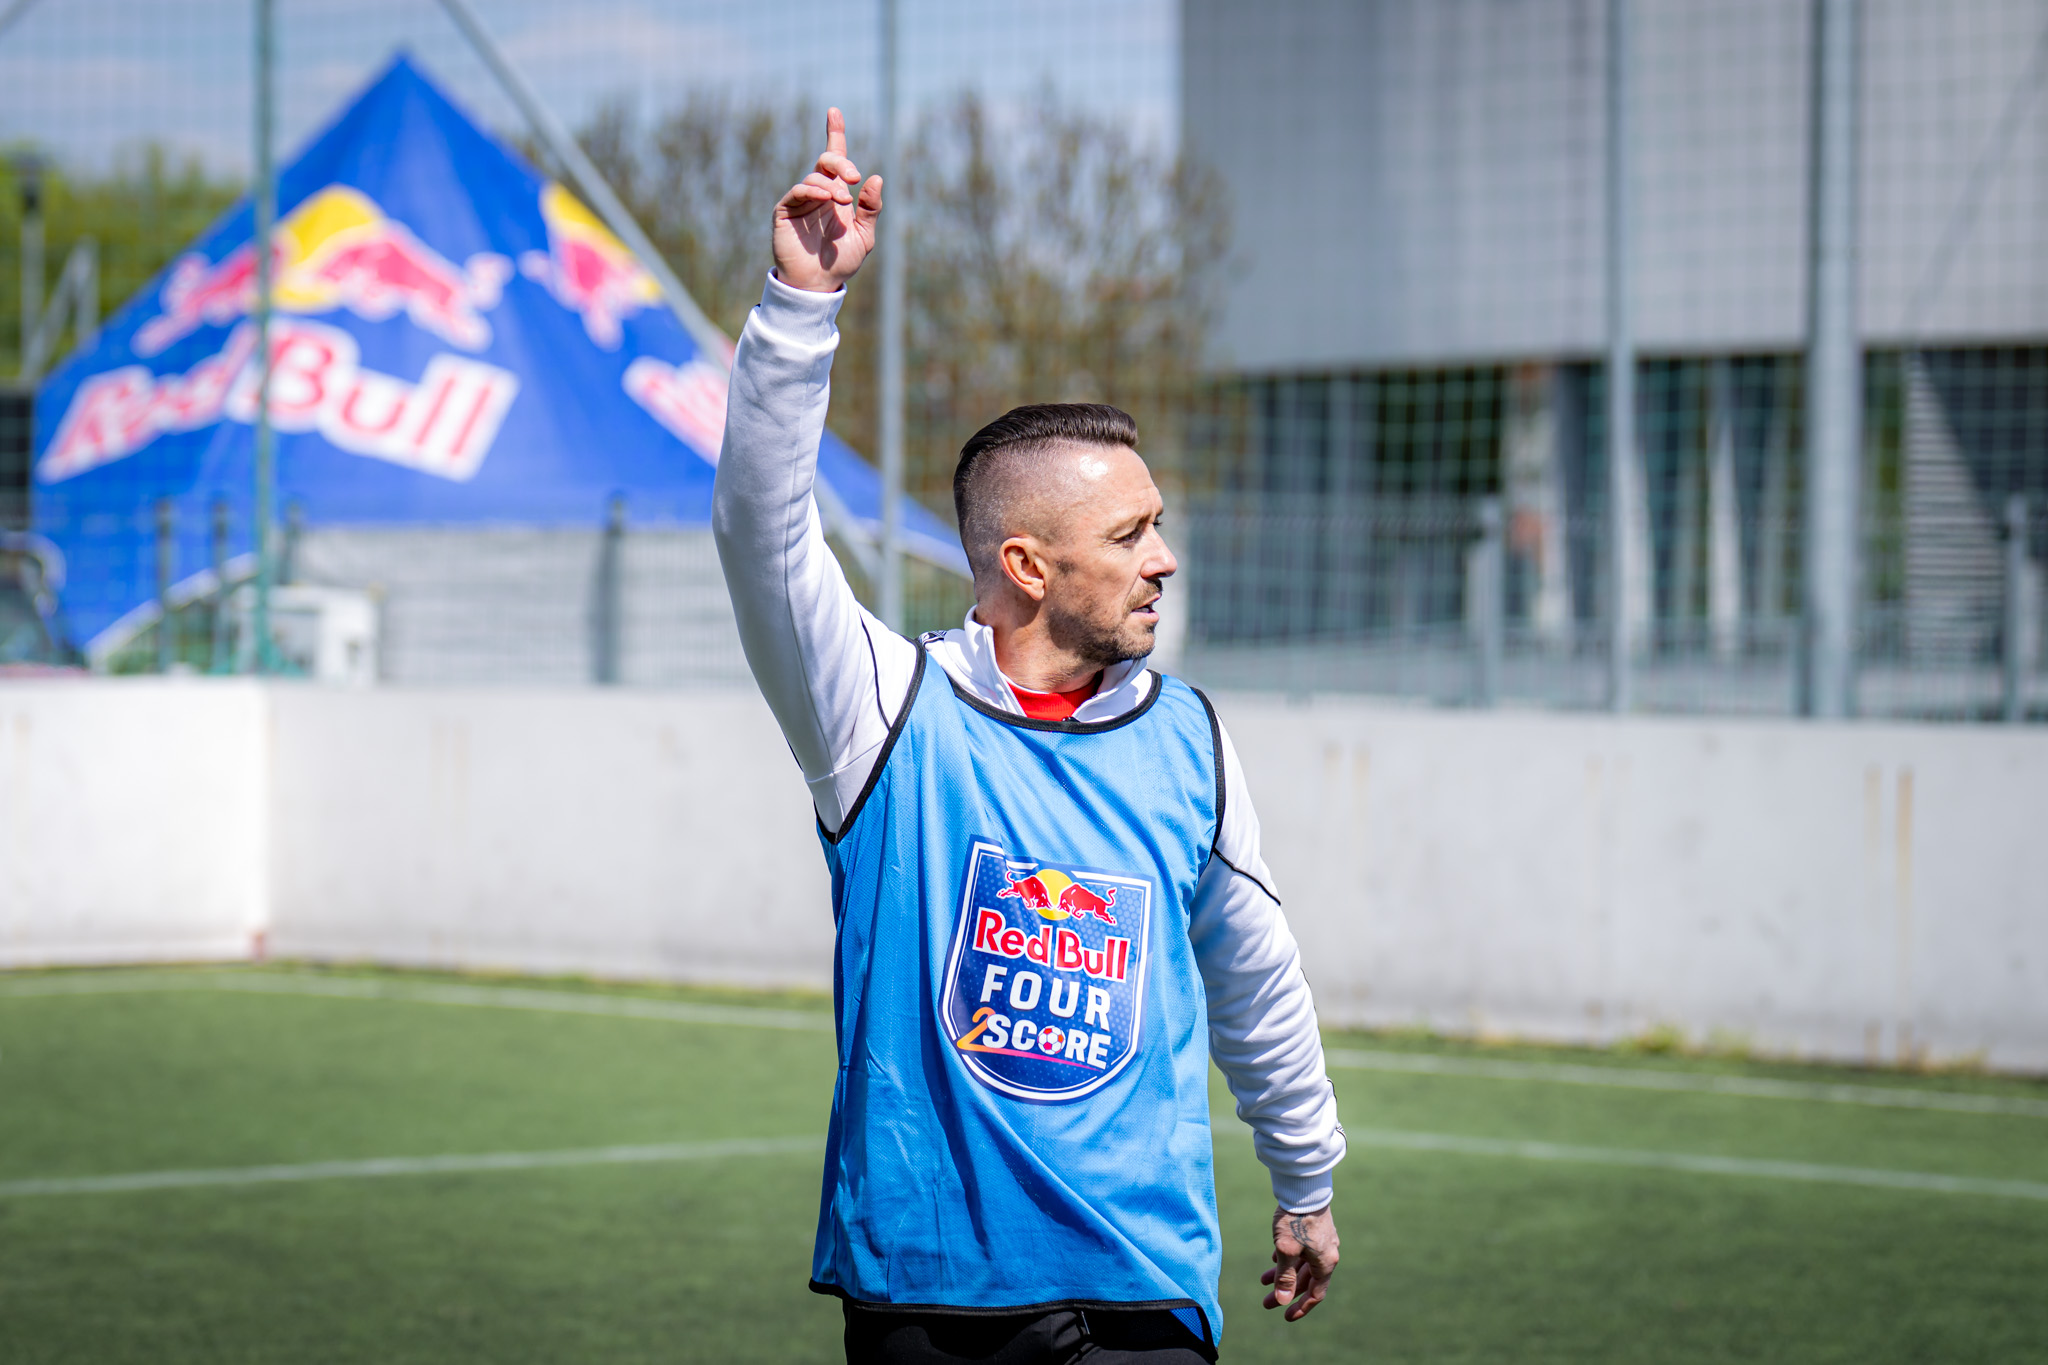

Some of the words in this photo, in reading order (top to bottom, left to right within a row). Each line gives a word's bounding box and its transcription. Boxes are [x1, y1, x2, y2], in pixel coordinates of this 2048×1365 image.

[248, 320, 514, 478] Bull
[974, 908, 1051, 965] Red
[1056, 929, 1129, 981] Bull
[980, 964, 1111, 1031] FOUR
